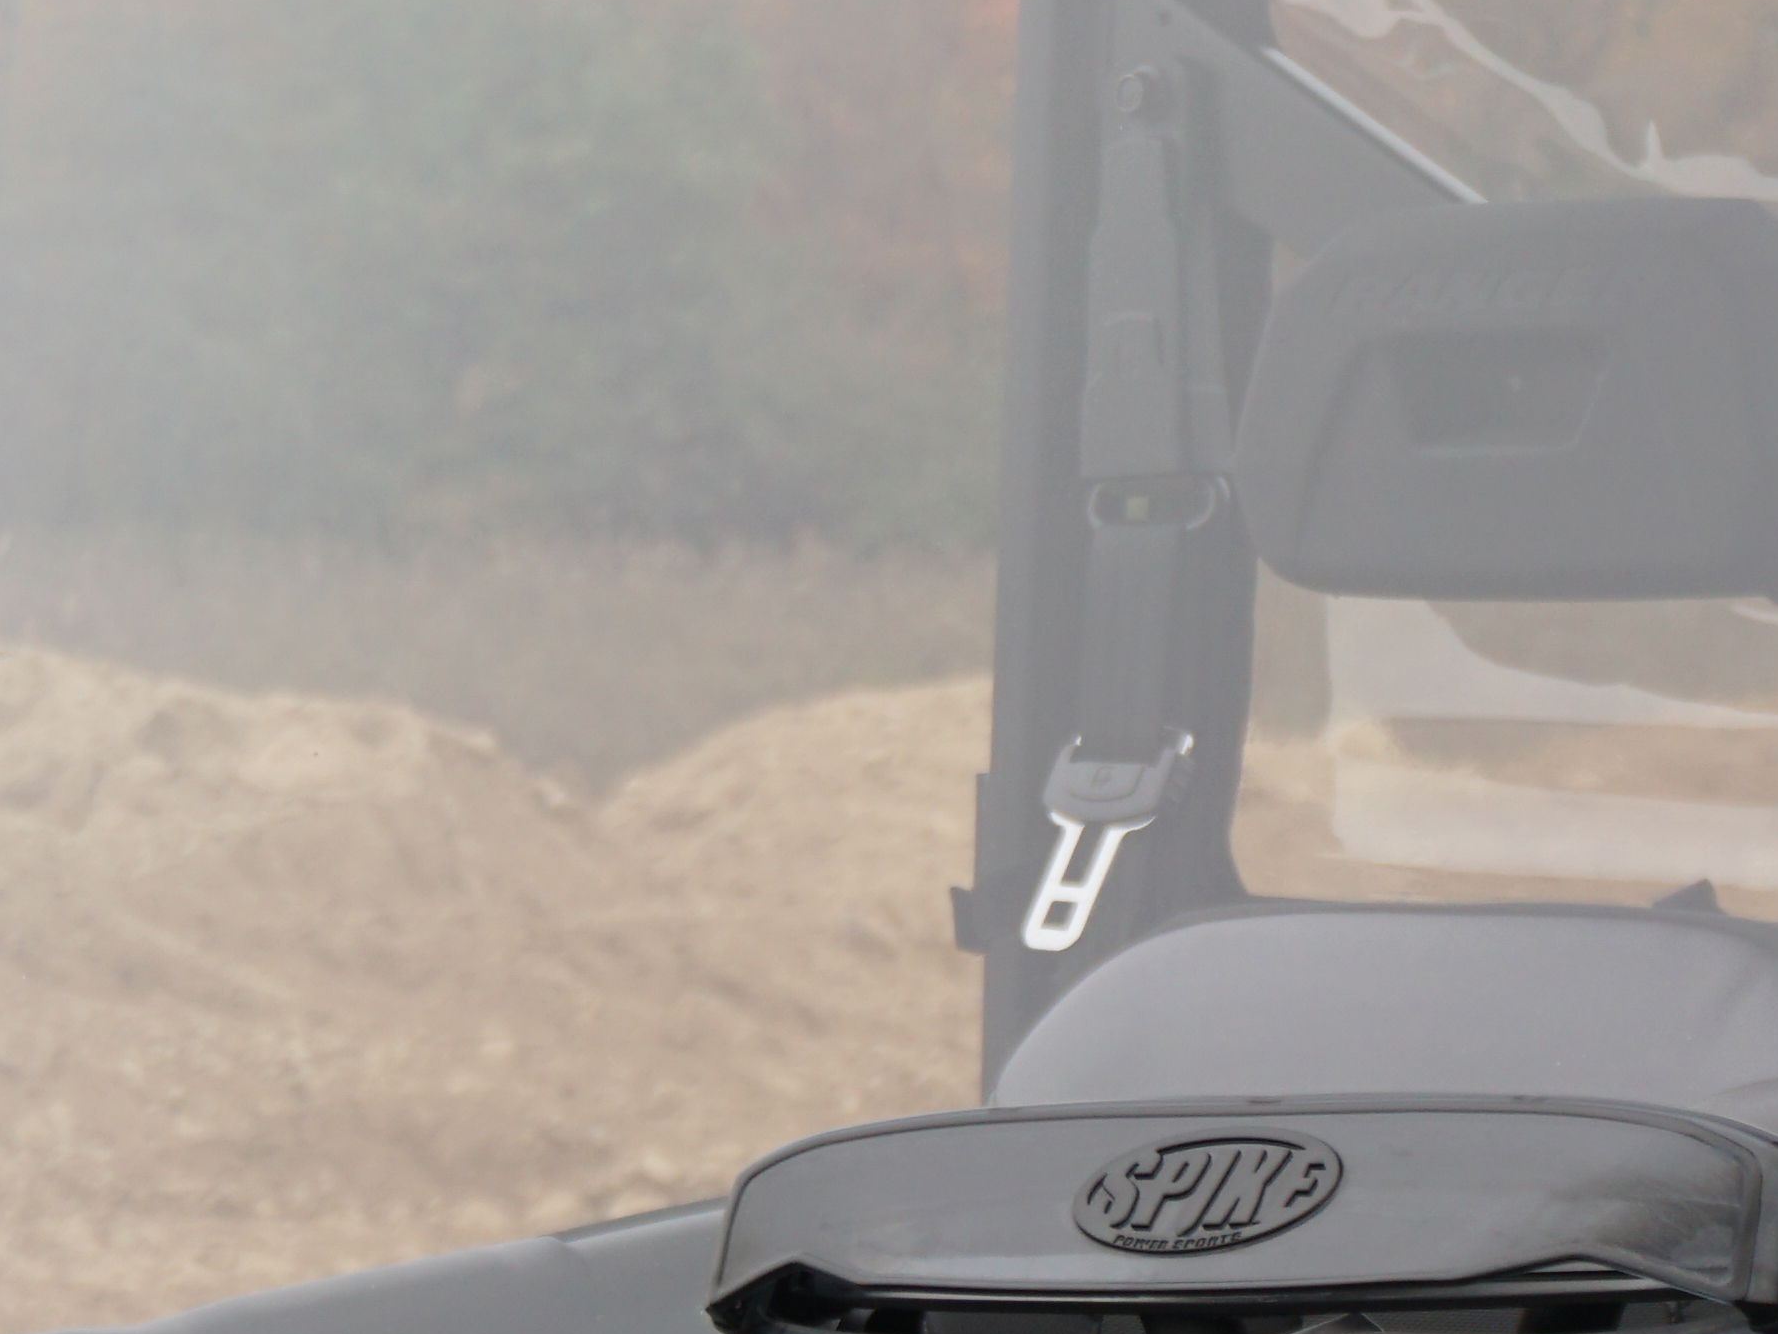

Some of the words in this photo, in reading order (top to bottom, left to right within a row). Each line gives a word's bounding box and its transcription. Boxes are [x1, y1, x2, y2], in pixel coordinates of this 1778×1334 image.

[1086, 1145, 1328, 1237] SPIKE
[1112, 1234, 1168, 1250] POWER
[1172, 1231, 1243, 1250] SPORTS
